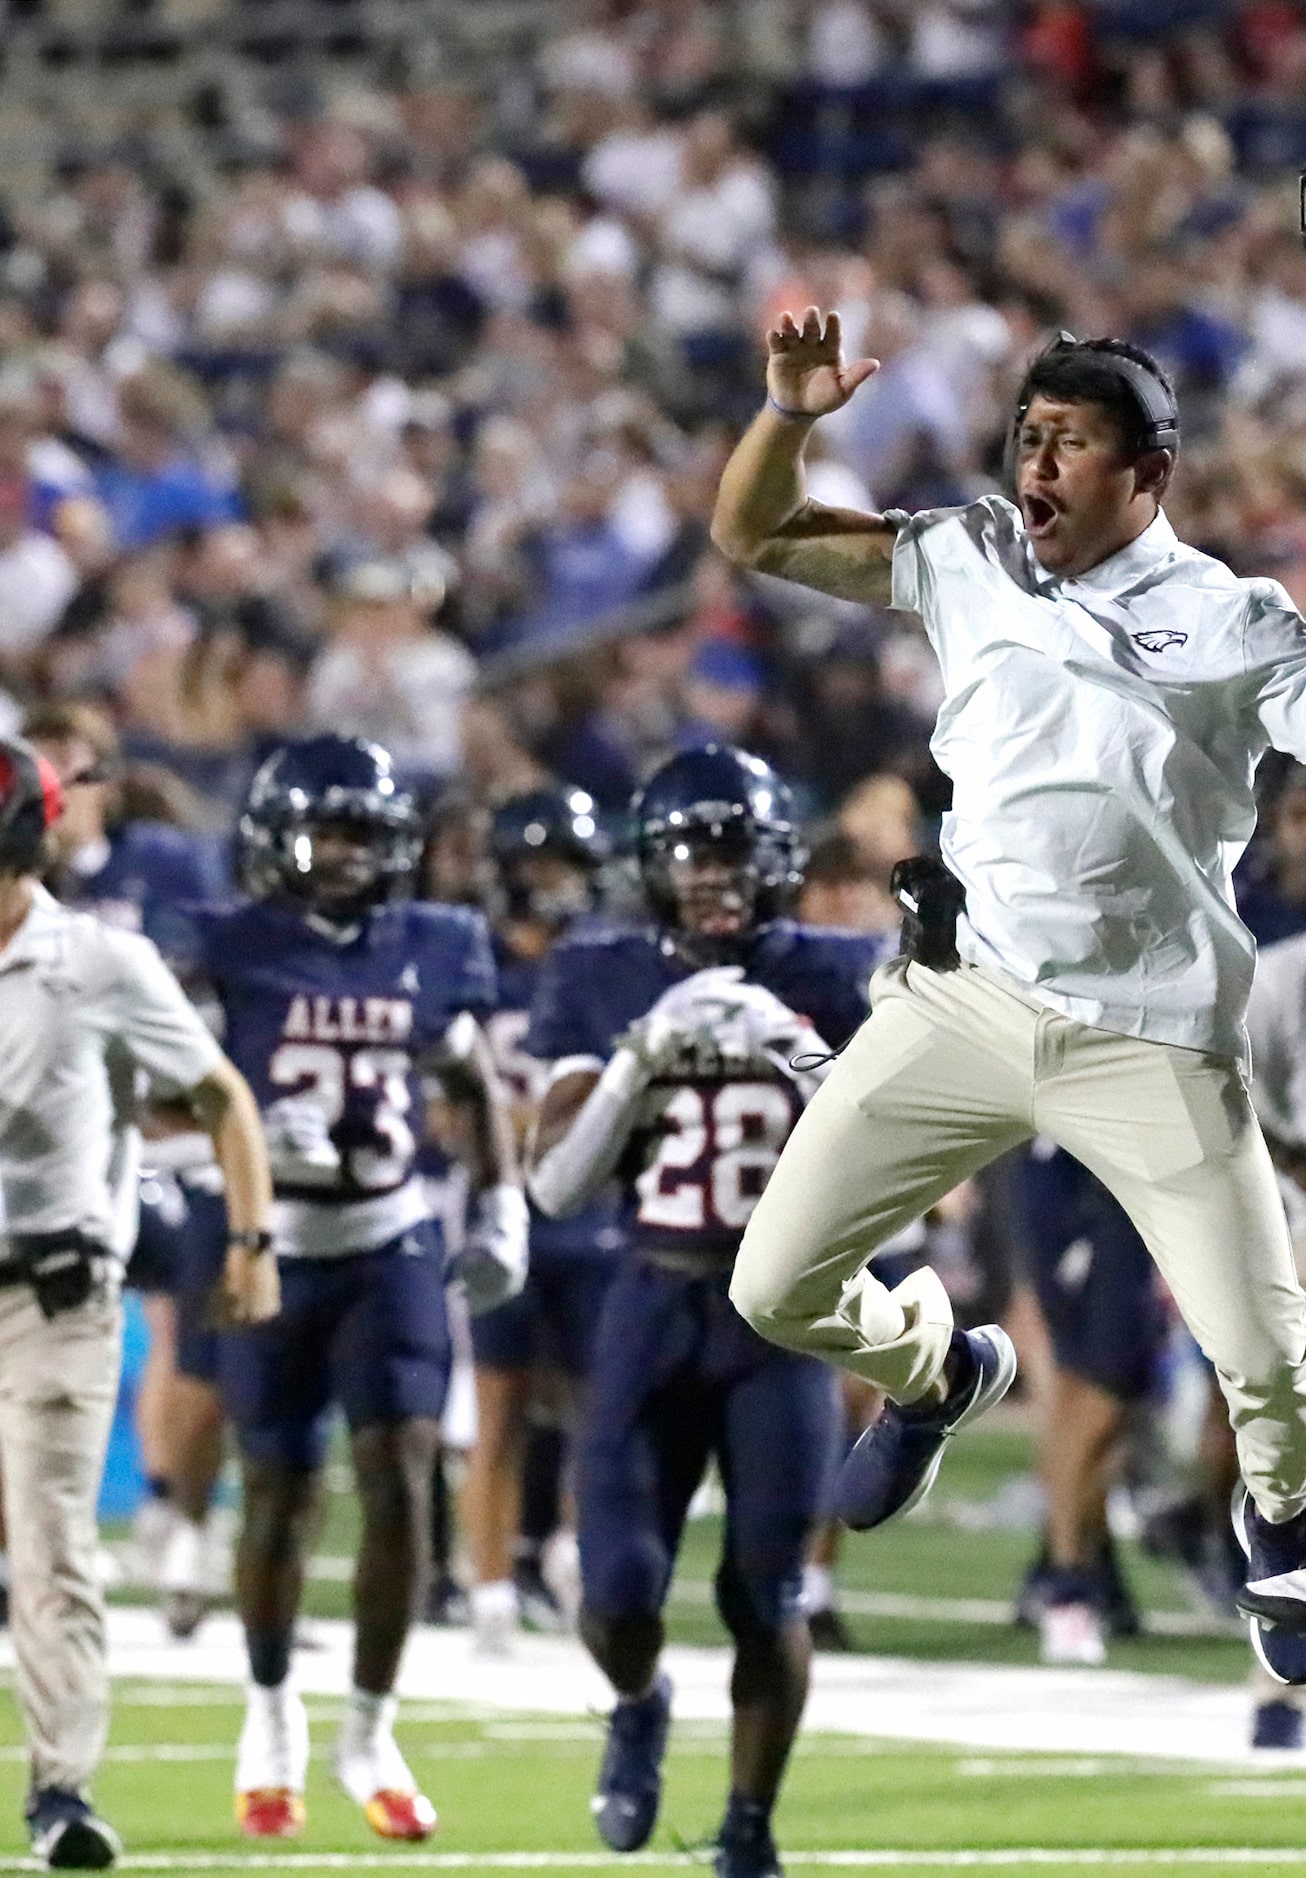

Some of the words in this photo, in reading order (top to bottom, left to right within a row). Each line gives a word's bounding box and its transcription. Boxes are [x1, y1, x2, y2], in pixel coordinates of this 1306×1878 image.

[283, 993, 414, 1044] ALLEN
[268, 1043, 416, 1188] 23
[637, 1082, 792, 1229] 28
